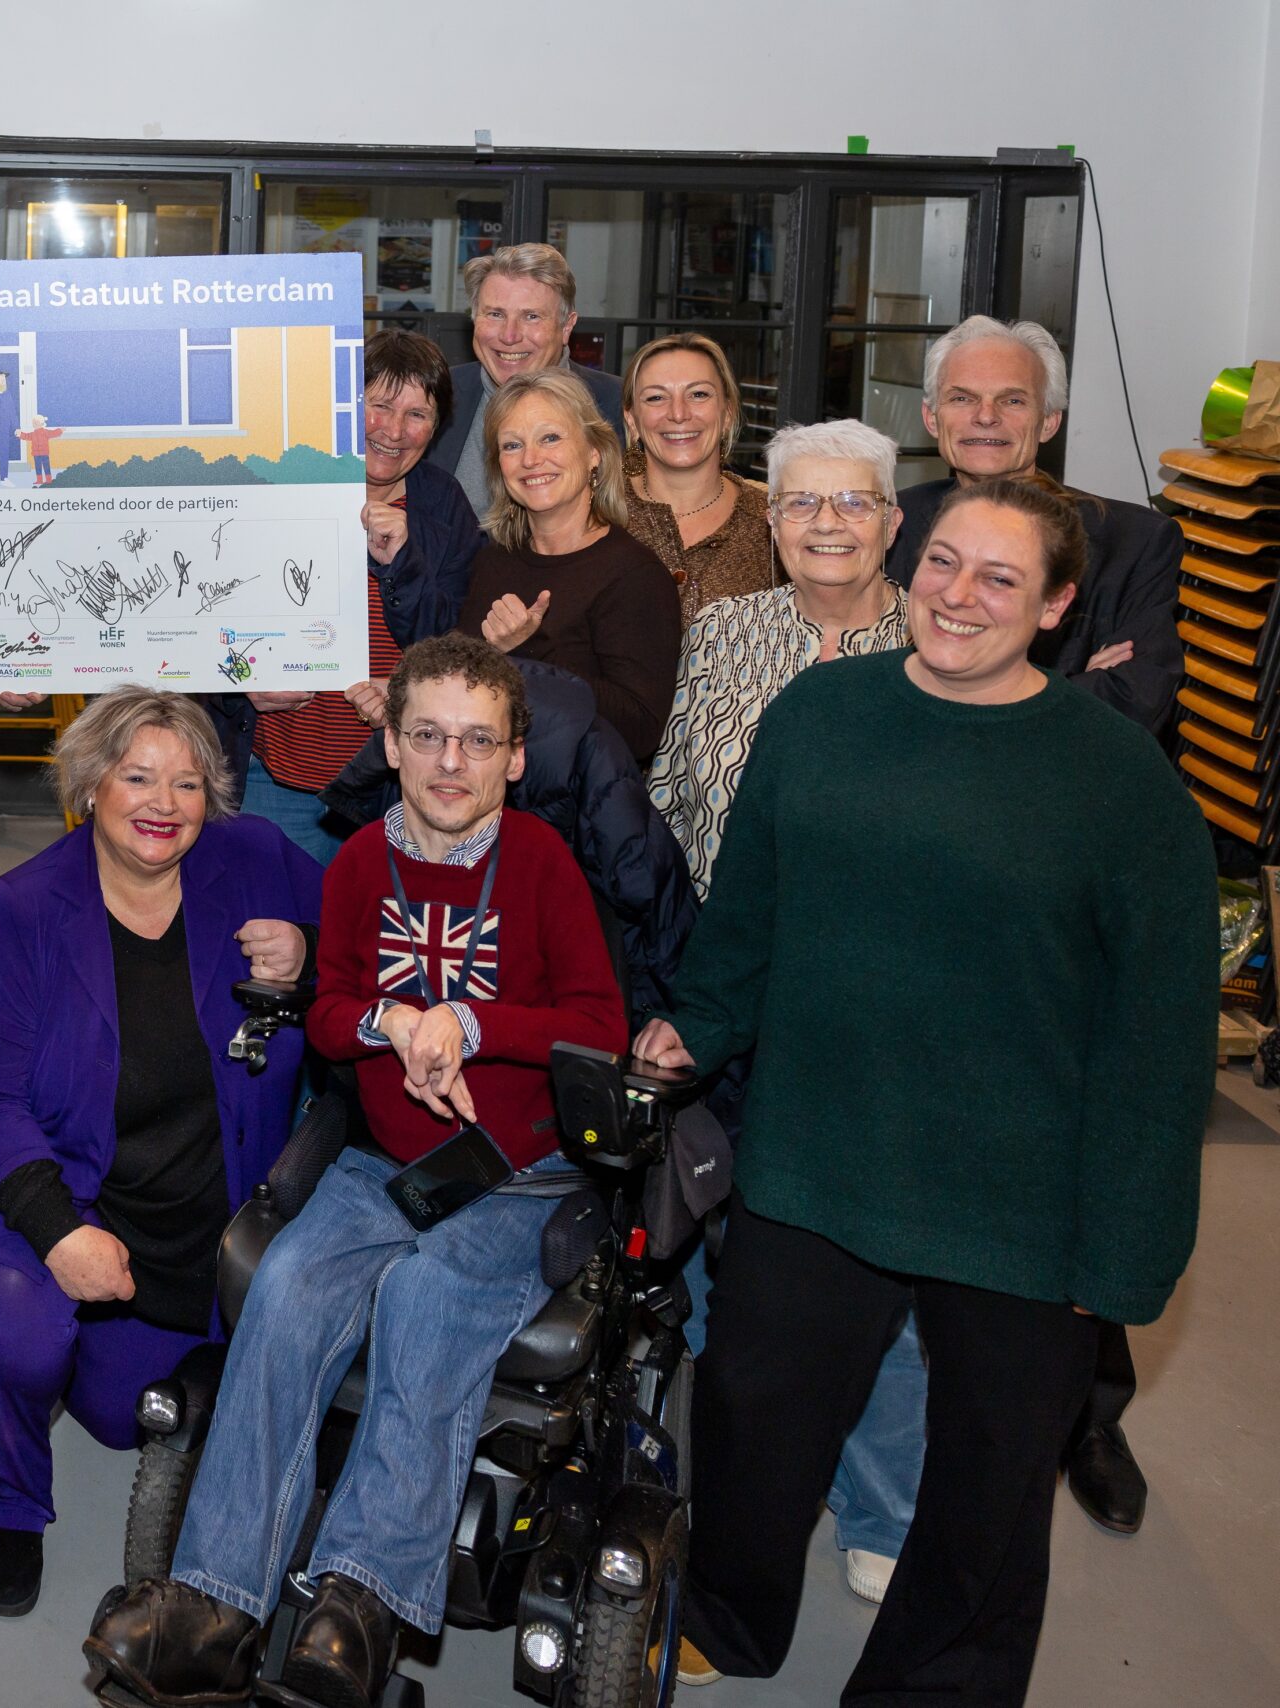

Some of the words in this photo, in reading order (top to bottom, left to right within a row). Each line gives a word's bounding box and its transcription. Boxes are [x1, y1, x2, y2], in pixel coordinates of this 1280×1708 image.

[49, 281, 163, 307] Statuut
[172, 277, 334, 304] Rotterdam
[21, 498, 114, 511] Ondertekend
[119, 497, 151, 510] door
[156, 497, 173, 509] de
[179, 496, 238, 512] partijen:
[99, 626, 125, 640] HEF
